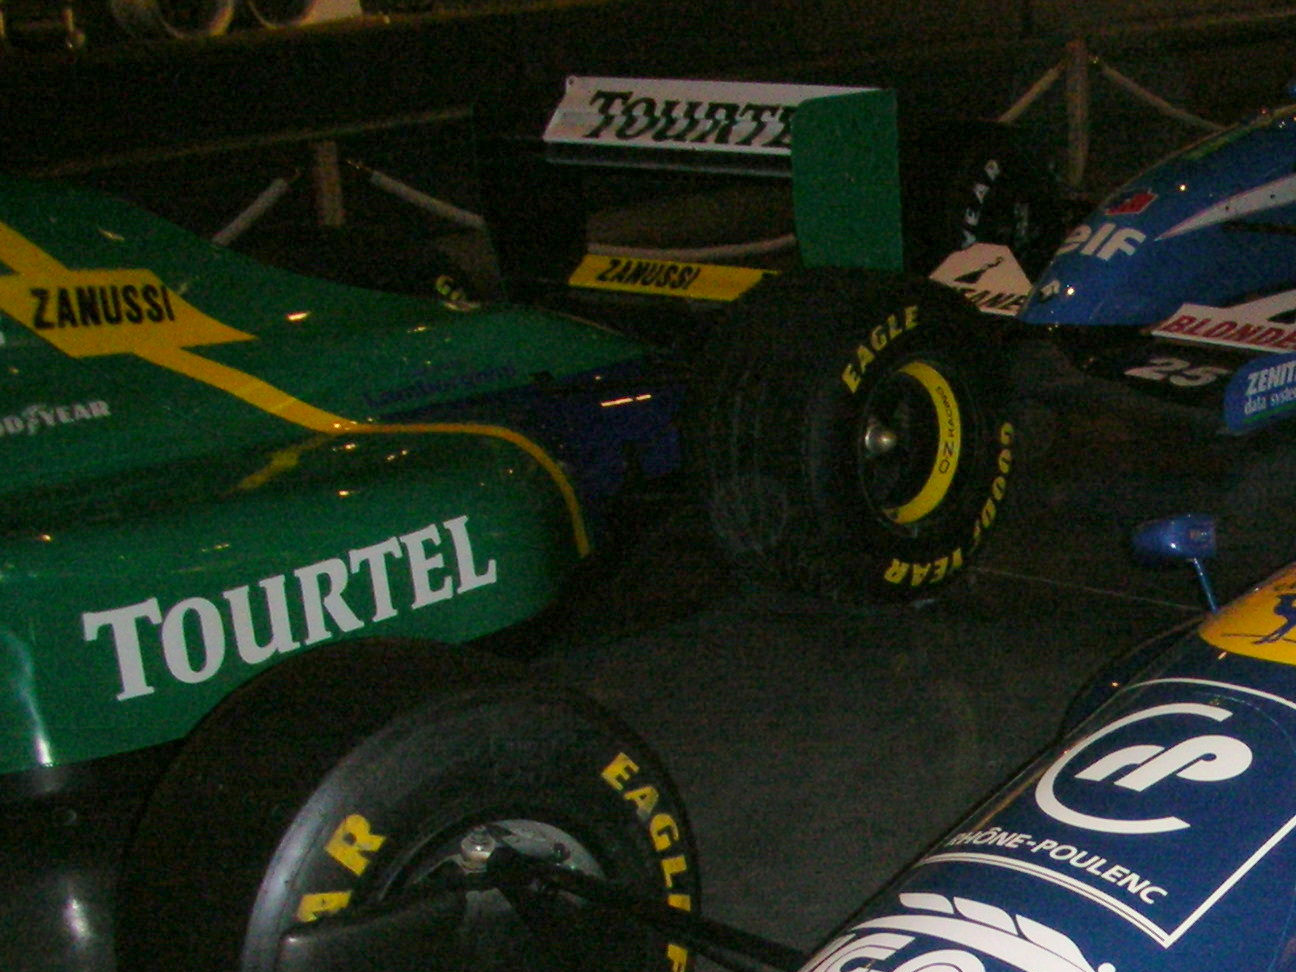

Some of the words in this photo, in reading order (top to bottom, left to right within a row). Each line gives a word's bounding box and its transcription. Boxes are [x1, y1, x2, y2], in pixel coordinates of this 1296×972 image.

[584, 91, 799, 146] TOURTE
[1056, 222, 1147, 261] elf
[597, 258, 701, 290] ZANUSSI
[31, 285, 176, 328] ZANUSSI
[841, 304, 919, 394] EAGLE
[1124, 356, 1231, 387] 25
[1243, 395, 1268, 416] data
[83, 514, 499, 701] TOURTEL
[949, 826, 1168, 905] RHÔNE-POULENC
